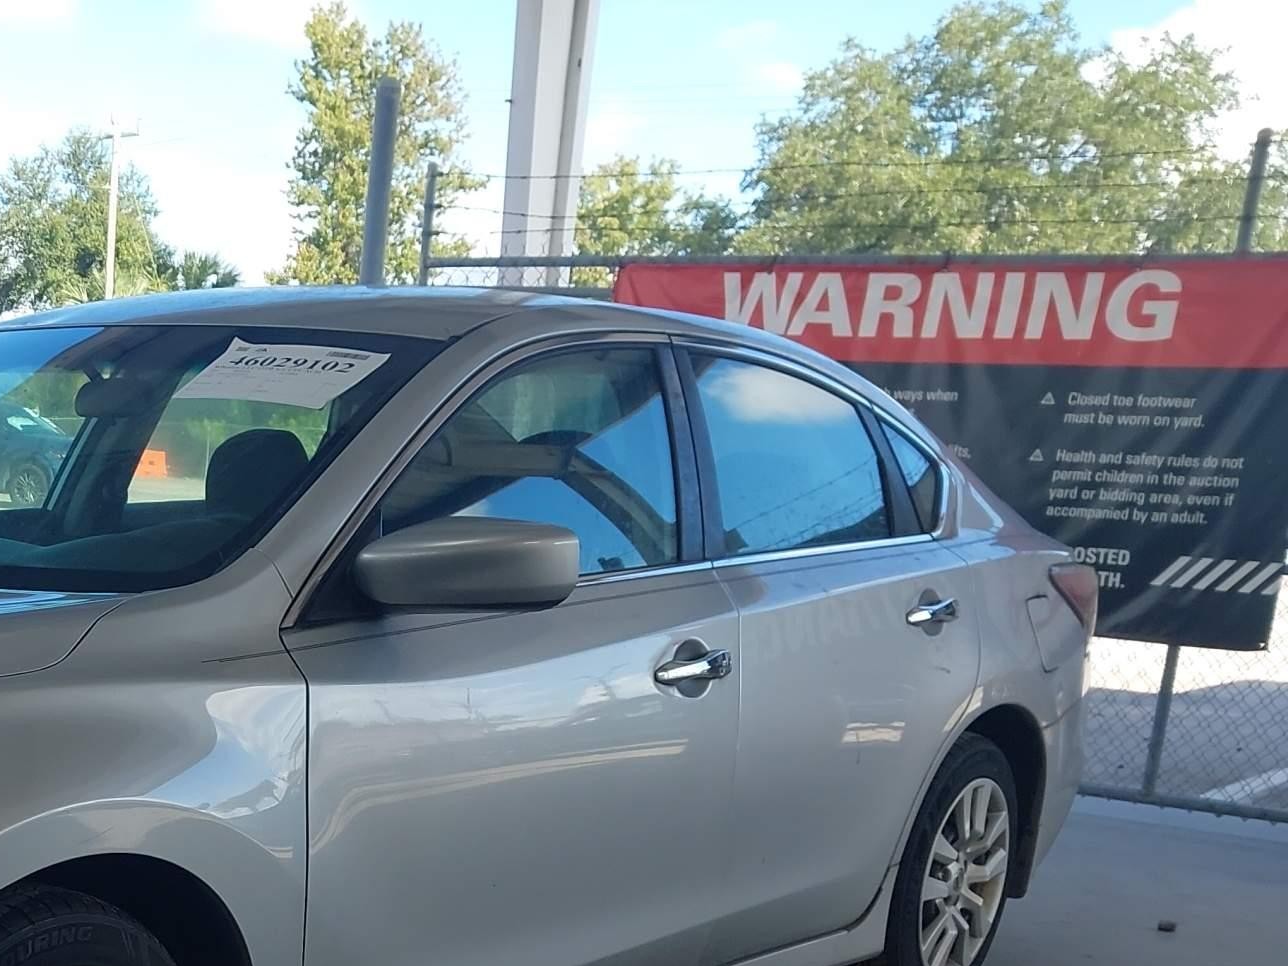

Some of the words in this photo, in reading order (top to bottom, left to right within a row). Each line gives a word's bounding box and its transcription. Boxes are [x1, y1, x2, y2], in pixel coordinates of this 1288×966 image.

[722, 268, 1183, 342] WARNING
[229, 355, 356, 373] 46029102
[893, 389, 924, 403] ways
[926, 389, 959, 402] when
[1068, 392, 1111, 406] Closed
[1112, 395, 1135, 407] toe
[1136, 393, 1197, 409] footwear
[1063, 412, 1095, 424] must
[1097, 411, 1114, 425] be
[1117, 414, 1150, 427] worn
[1153, 415, 1170, 427] on
[1173, 414, 1206, 431] yard.
[1056, 448, 1096, 464] Health
[1098, 451, 1123, 465] and
[1125, 453, 1165, 469] safety
[1167, 455, 1200, 468] rules
[1202, 456, 1219, 469] do
[1221, 457, 1244, 470] not
[1051, 469, 1092, 483] permit
[1095, 470, 1144, 485] children
[1147, 471, 1159, 485] in
[1162, 472, 1185, 487] the
[1188, 474, 1240, 489] auction
[1048, 486, 1079, 501] yard
[1081, 489, 1097, 500] or
[1098, 488, 1145, 506] bidding
[1149, 492, 1183, 507] area,
[1186, 494, 1221, 507] even
[1224, 493, 1235, 507] if
[1046, 504, 1129, 522] accompanied
[1132, 508, 1148, 524] by
[1151, 511, 1168, 523] an
[1170, 510, 1208, 525] adult.
[1073, 546, 1130, 566] OSTED
[1098, 571, 1125, 588] TH.
